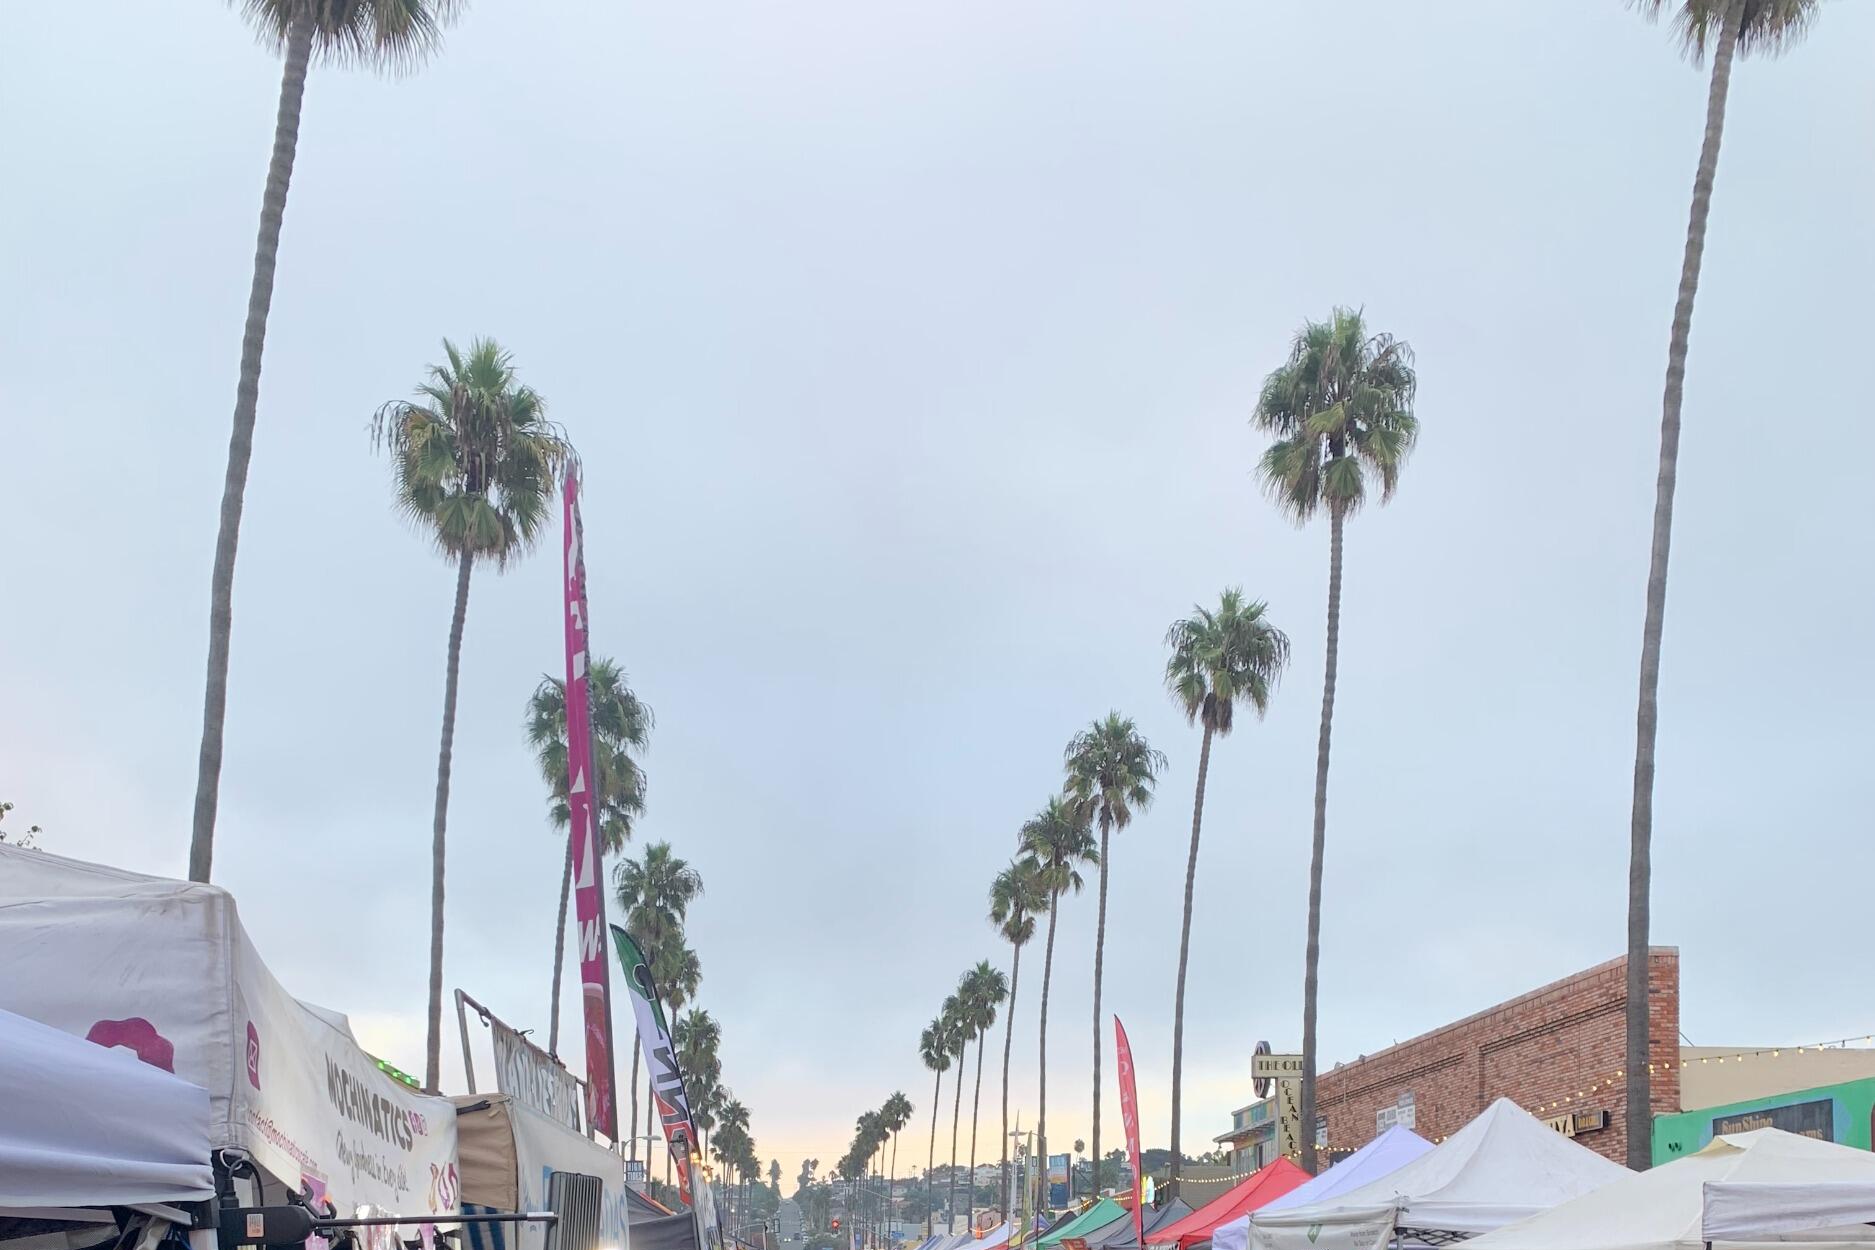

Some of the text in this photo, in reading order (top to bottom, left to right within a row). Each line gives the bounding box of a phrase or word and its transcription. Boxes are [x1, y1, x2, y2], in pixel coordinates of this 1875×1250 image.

[1259, 1060, 1303, 1070] THE OL
[325, 1052, 413, 1152] MOCHINATICS
[1281, 1080, 1299, 1121] OCEAN
[1281, 1116, 1298, 1154] BEAC
